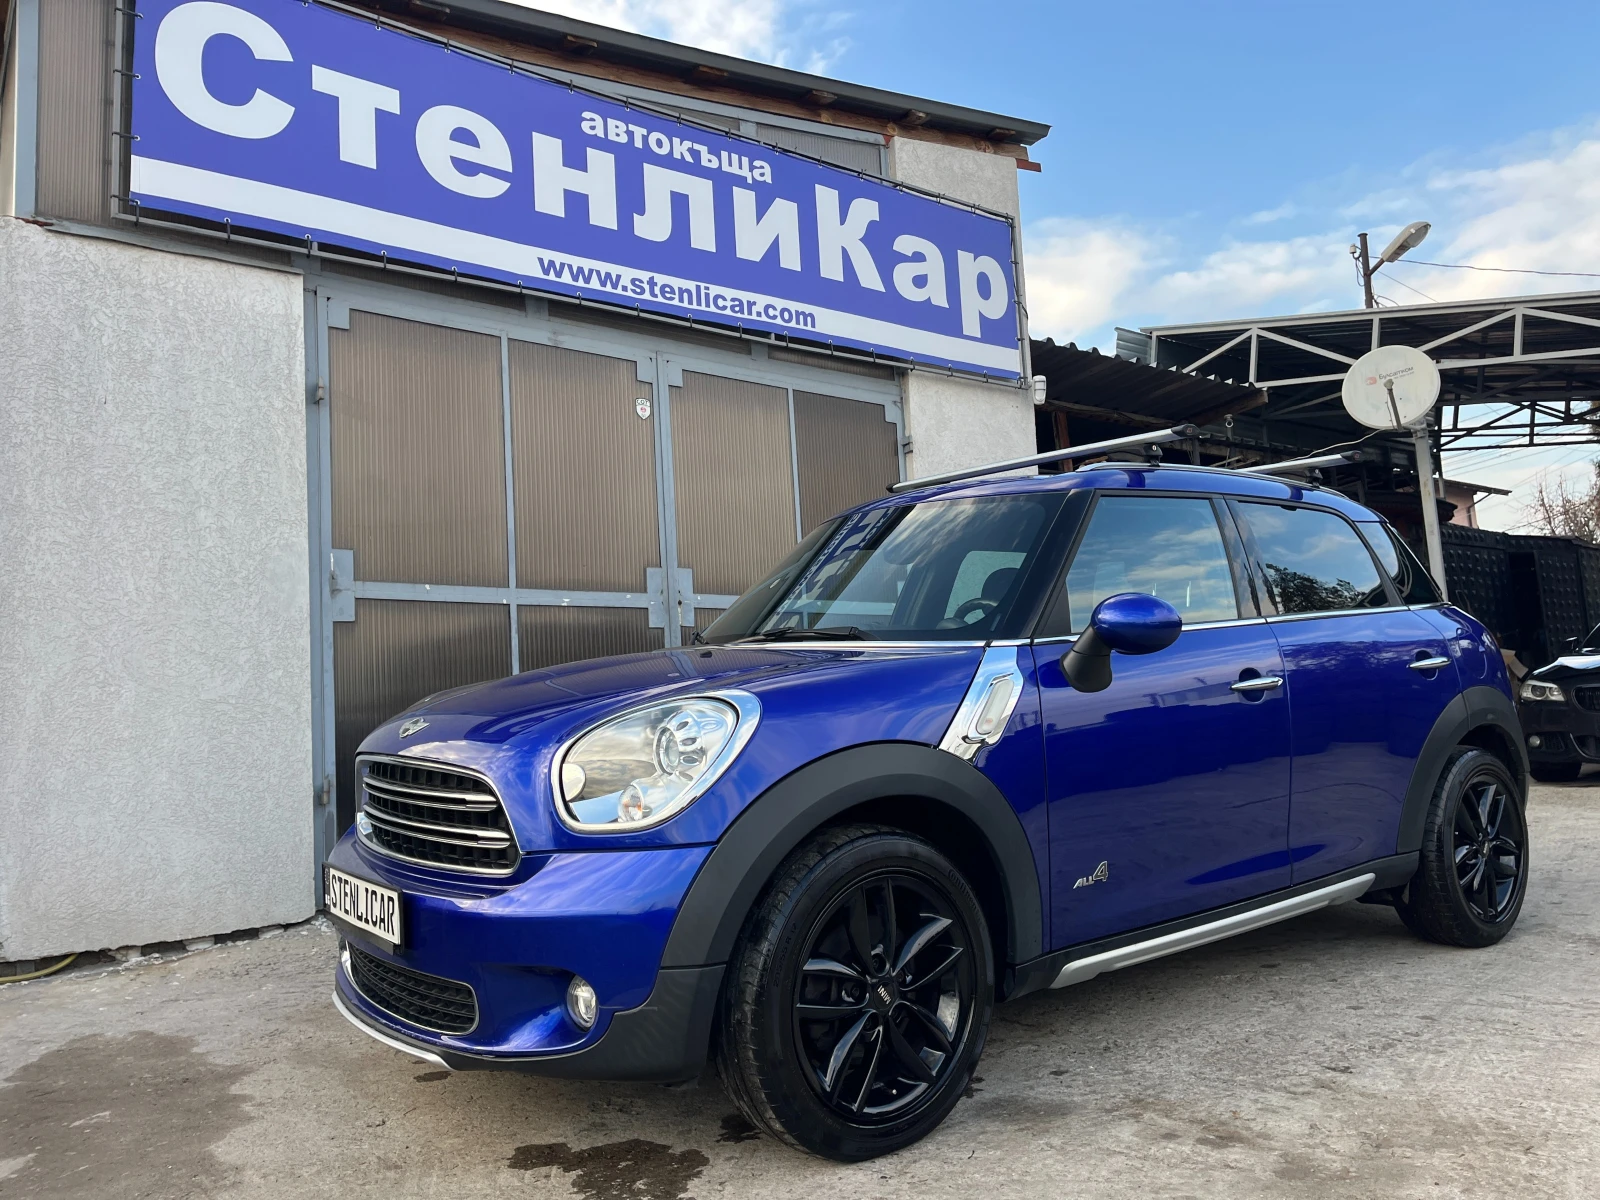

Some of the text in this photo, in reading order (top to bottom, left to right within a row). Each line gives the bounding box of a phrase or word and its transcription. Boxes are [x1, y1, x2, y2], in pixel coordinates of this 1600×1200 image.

[154, 1, 1009, 338] СтенлиКар
[580, 111, 772, 184] автокъща
[537, 256, 816, 329] www.stenlicar.com
[331, 873, 395, 936] STENLICAR
[877, 985, 891, 1004] MINI
